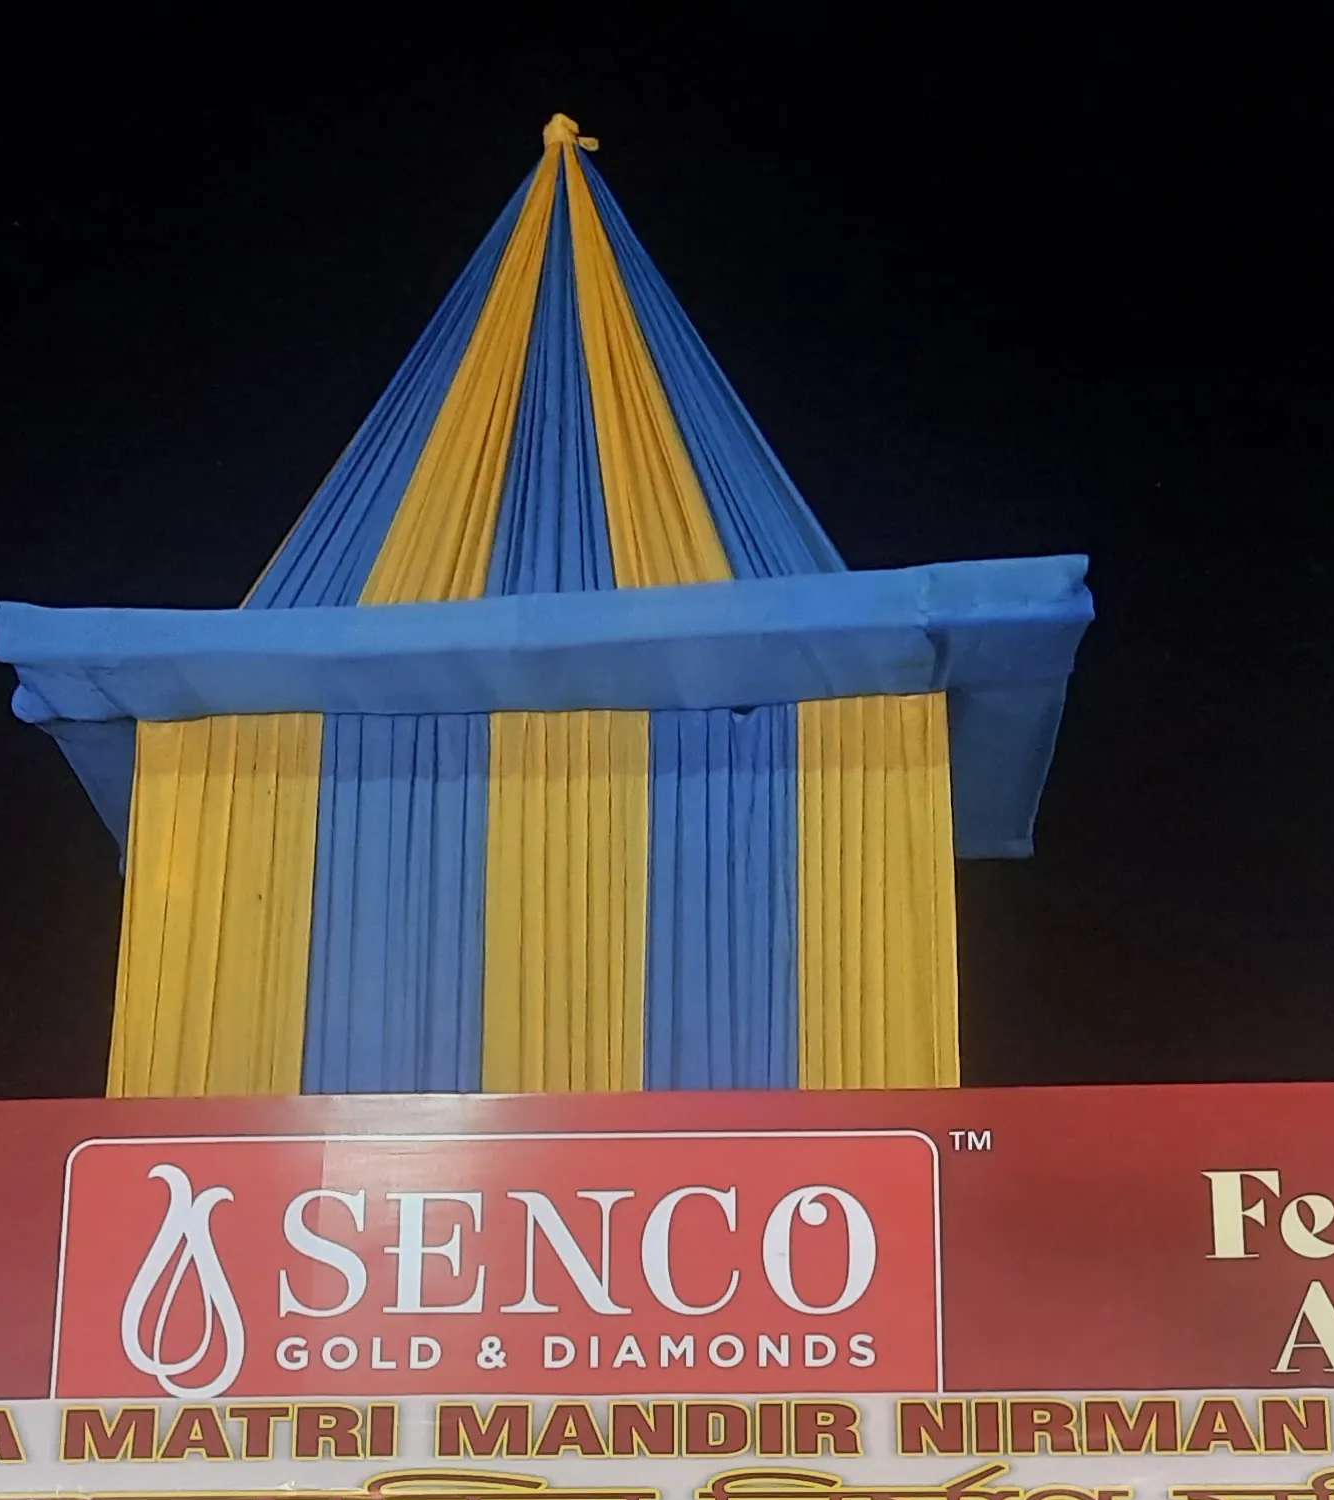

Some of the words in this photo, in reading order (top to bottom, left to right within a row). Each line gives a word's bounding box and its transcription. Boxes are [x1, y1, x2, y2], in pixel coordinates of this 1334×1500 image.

[949, 1129, 993, 1152] TM
[277, 1184, 878, 1317] SENCO
[274, 1334, 444, 1371] GOLD
[476, 1334, 509, 1371] &
[543, 1332, 878, 1370] DIAMONDS
[59, 1401, 400, 1463] MATRI
[431, 1397, 865, 1460] MANDIR
[895, 1395, 1332, 1458] NIRMAN
